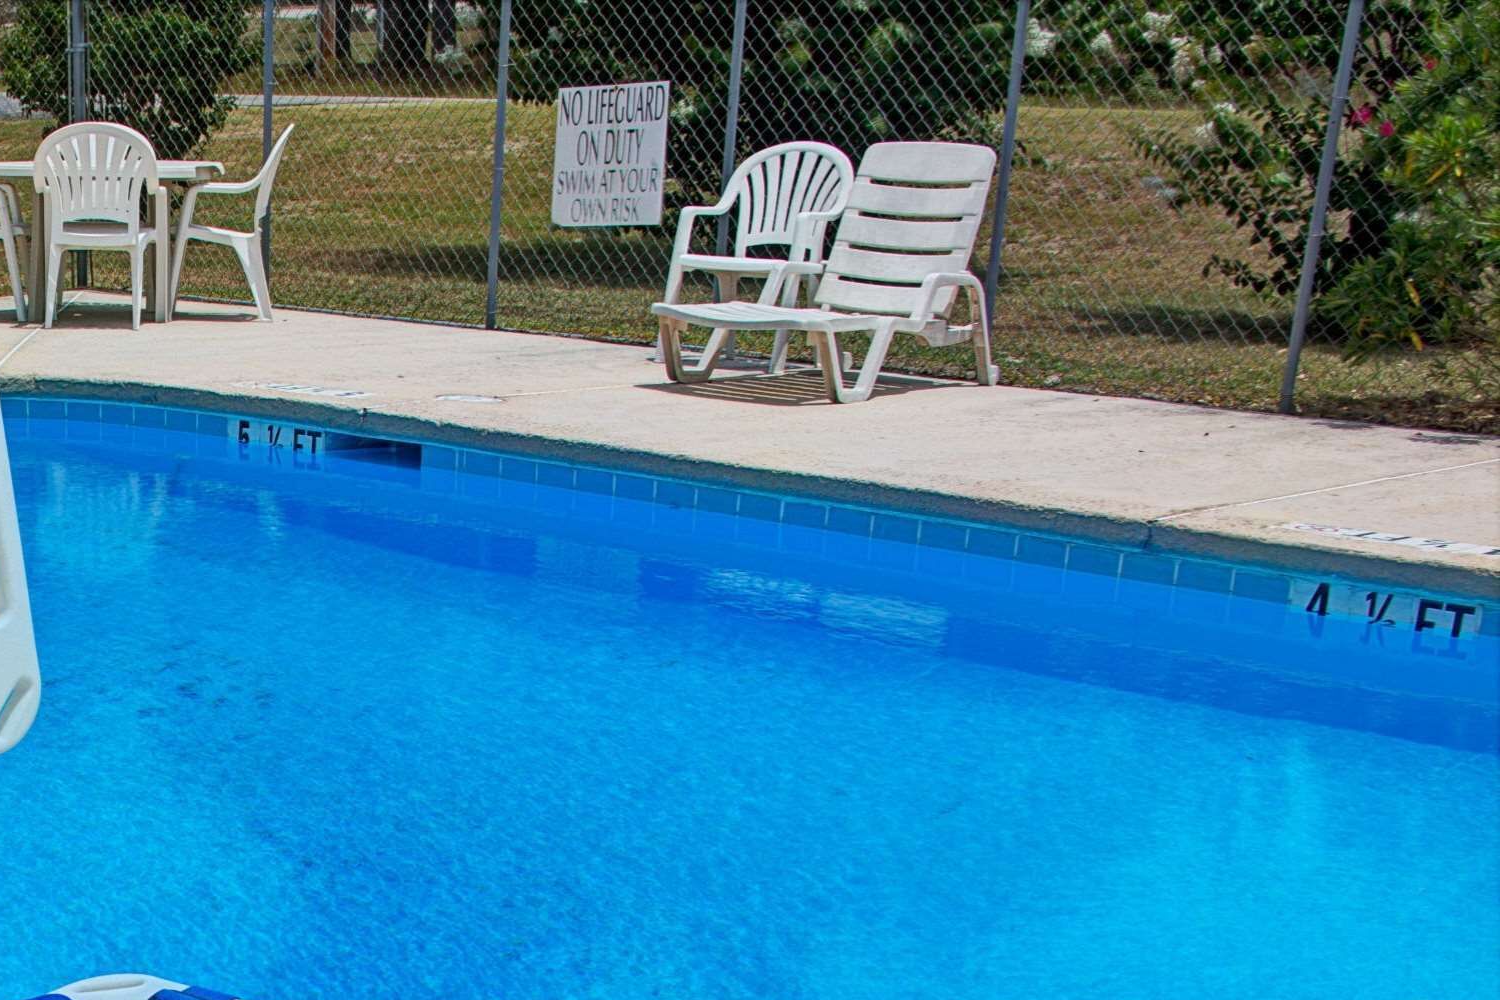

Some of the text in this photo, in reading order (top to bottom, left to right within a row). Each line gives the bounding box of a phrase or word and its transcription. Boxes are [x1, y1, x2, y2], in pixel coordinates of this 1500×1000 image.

[559, 85, 665, 127] NO LIFEGUARD
[576, 128, 645, 166] ON DUTY
[556, 167, 658, 196] SWIM AT YOUR
[570, 197, 641, 223] OWN RISK
[293, 429, 322, 454] FT
[1306, 582, 1330, 617] 4
[1414, 598, 1476, 638] FT
